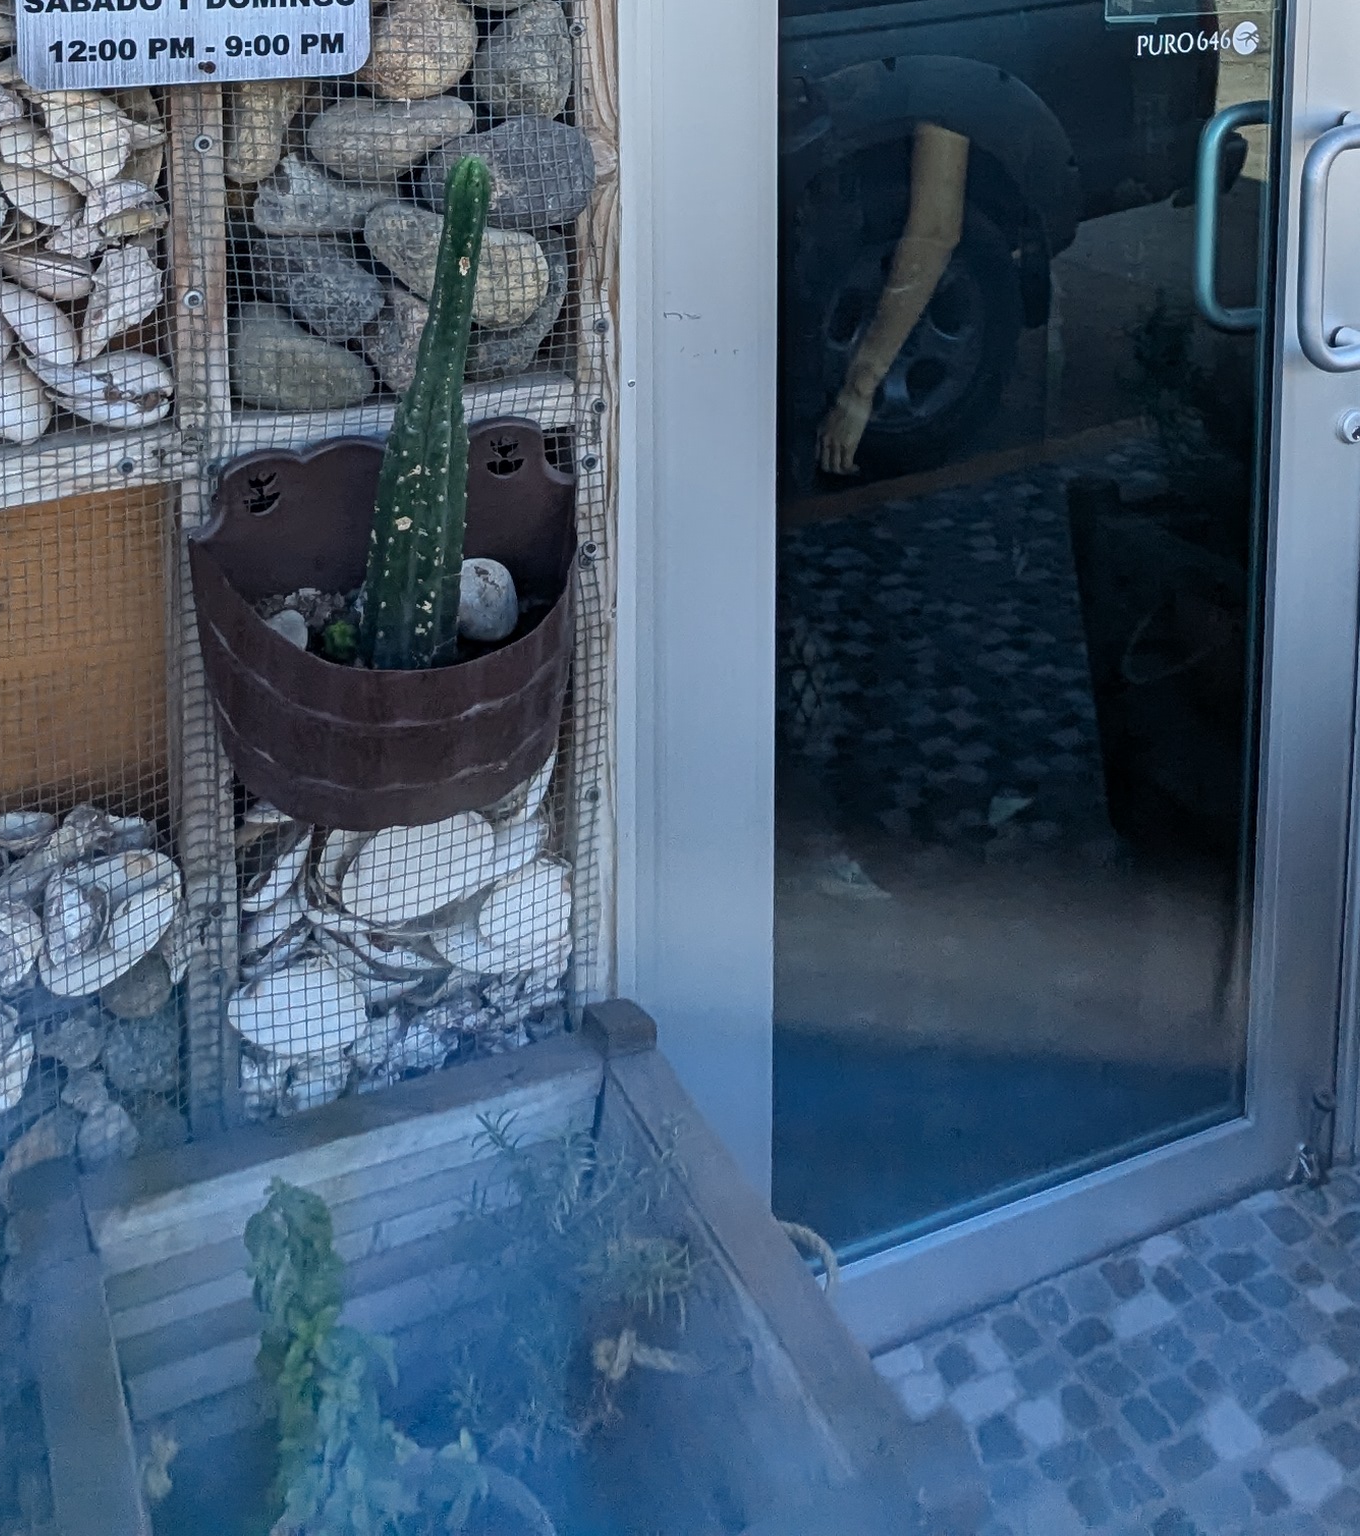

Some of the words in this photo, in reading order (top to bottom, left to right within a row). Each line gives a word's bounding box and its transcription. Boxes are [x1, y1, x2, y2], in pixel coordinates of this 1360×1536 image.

[48, 38, 137, 64] 12:00
[148, 37, 195, 60] PM
[225, 34, 290, 57] 9:00
[301, 33, 344, 55] PM
[1136, 31, 1194, 57] PURO
[1197, 28, 1231, 52] 646
